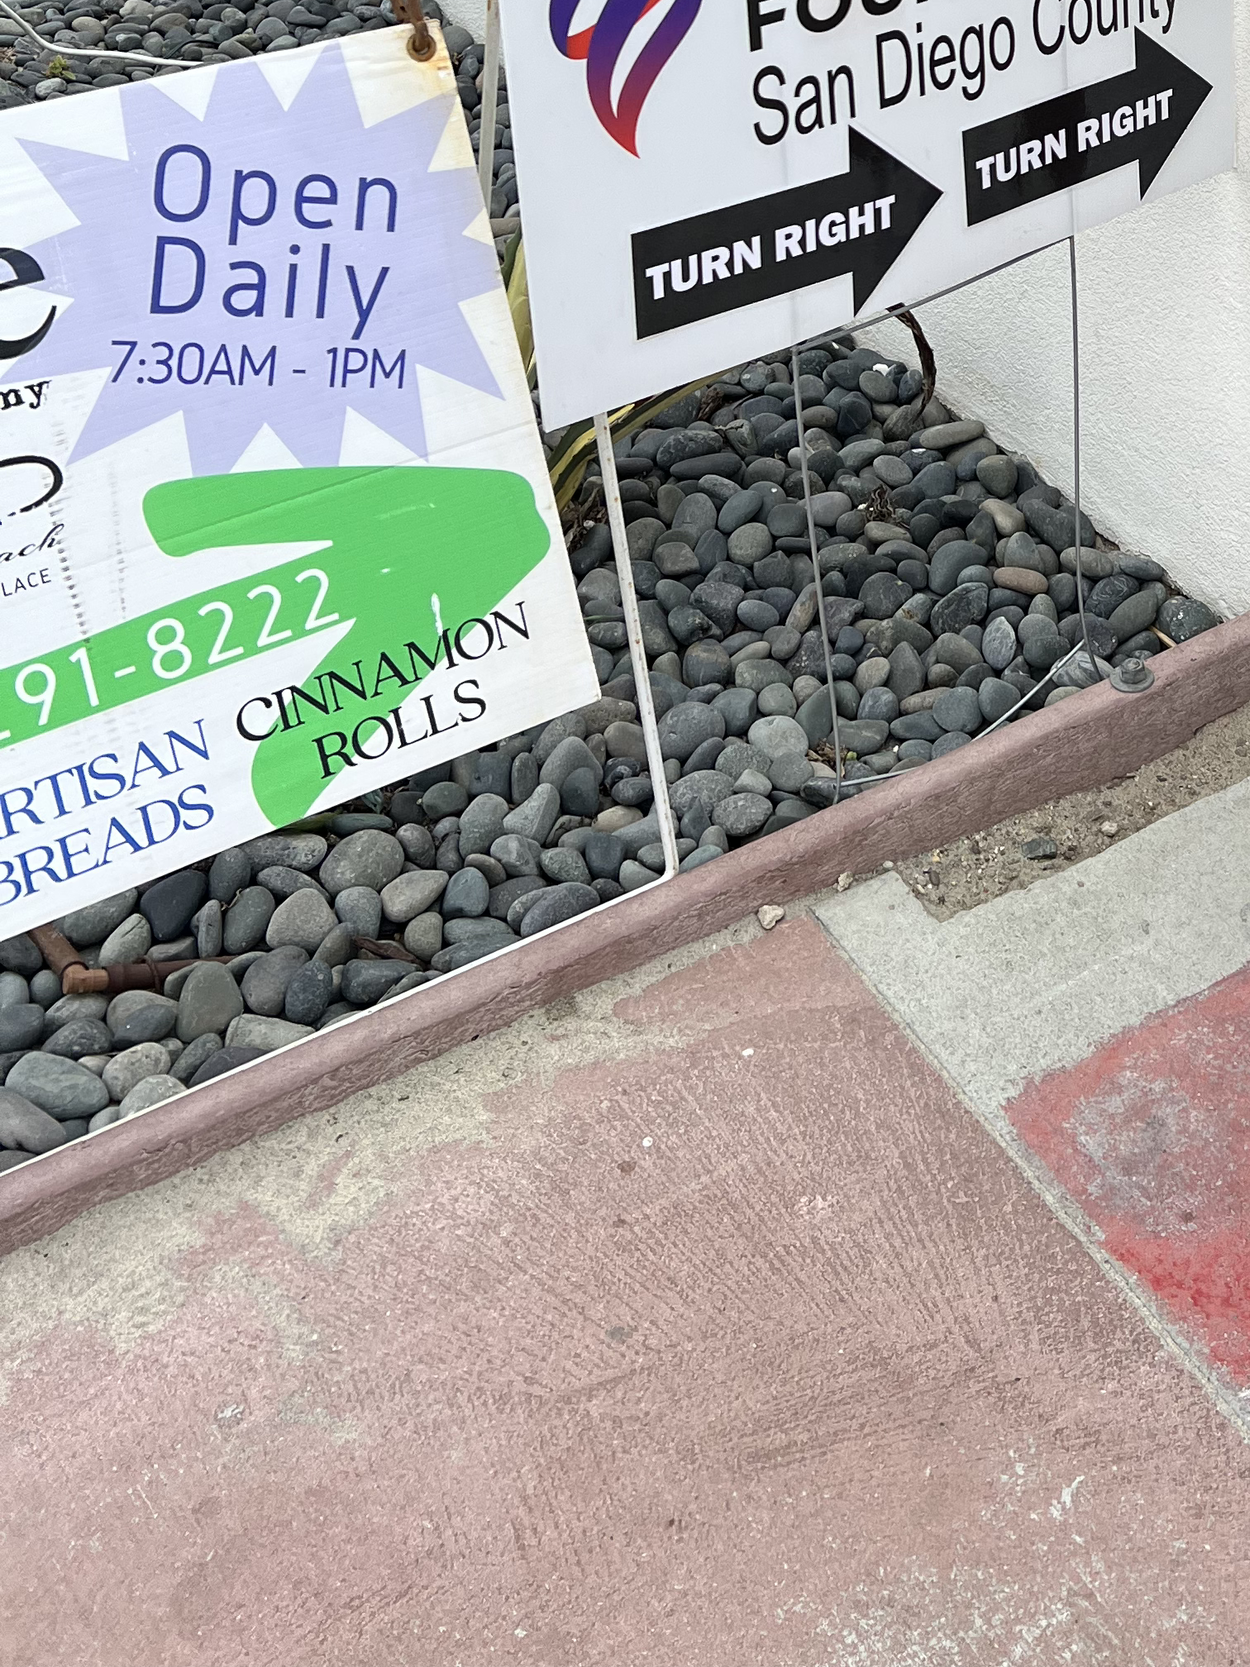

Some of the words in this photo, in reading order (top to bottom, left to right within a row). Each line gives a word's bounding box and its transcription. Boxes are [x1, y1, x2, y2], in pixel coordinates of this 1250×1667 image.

[752, 64, 857, 146] San
[875, 13, 1016, 109] Diego
[976, 127, 1068, 191] TURN
[1076, 87, 1175, 152] RIGHT
[152, 142, 399, 246] Open
[644, 235, 763, 300] TURN
[774, 194, 897, 264] RIGHT
[149, 235, 391, 341] Daily
[110, 339, 277, 388] 7:30AM
[327, 347, 407, 391] 1PM
[236, 601, 533, 743] CINNAMON
[0, 719, 213, 841] RTISAN
[312, 679, 488, 780] ROLLS
